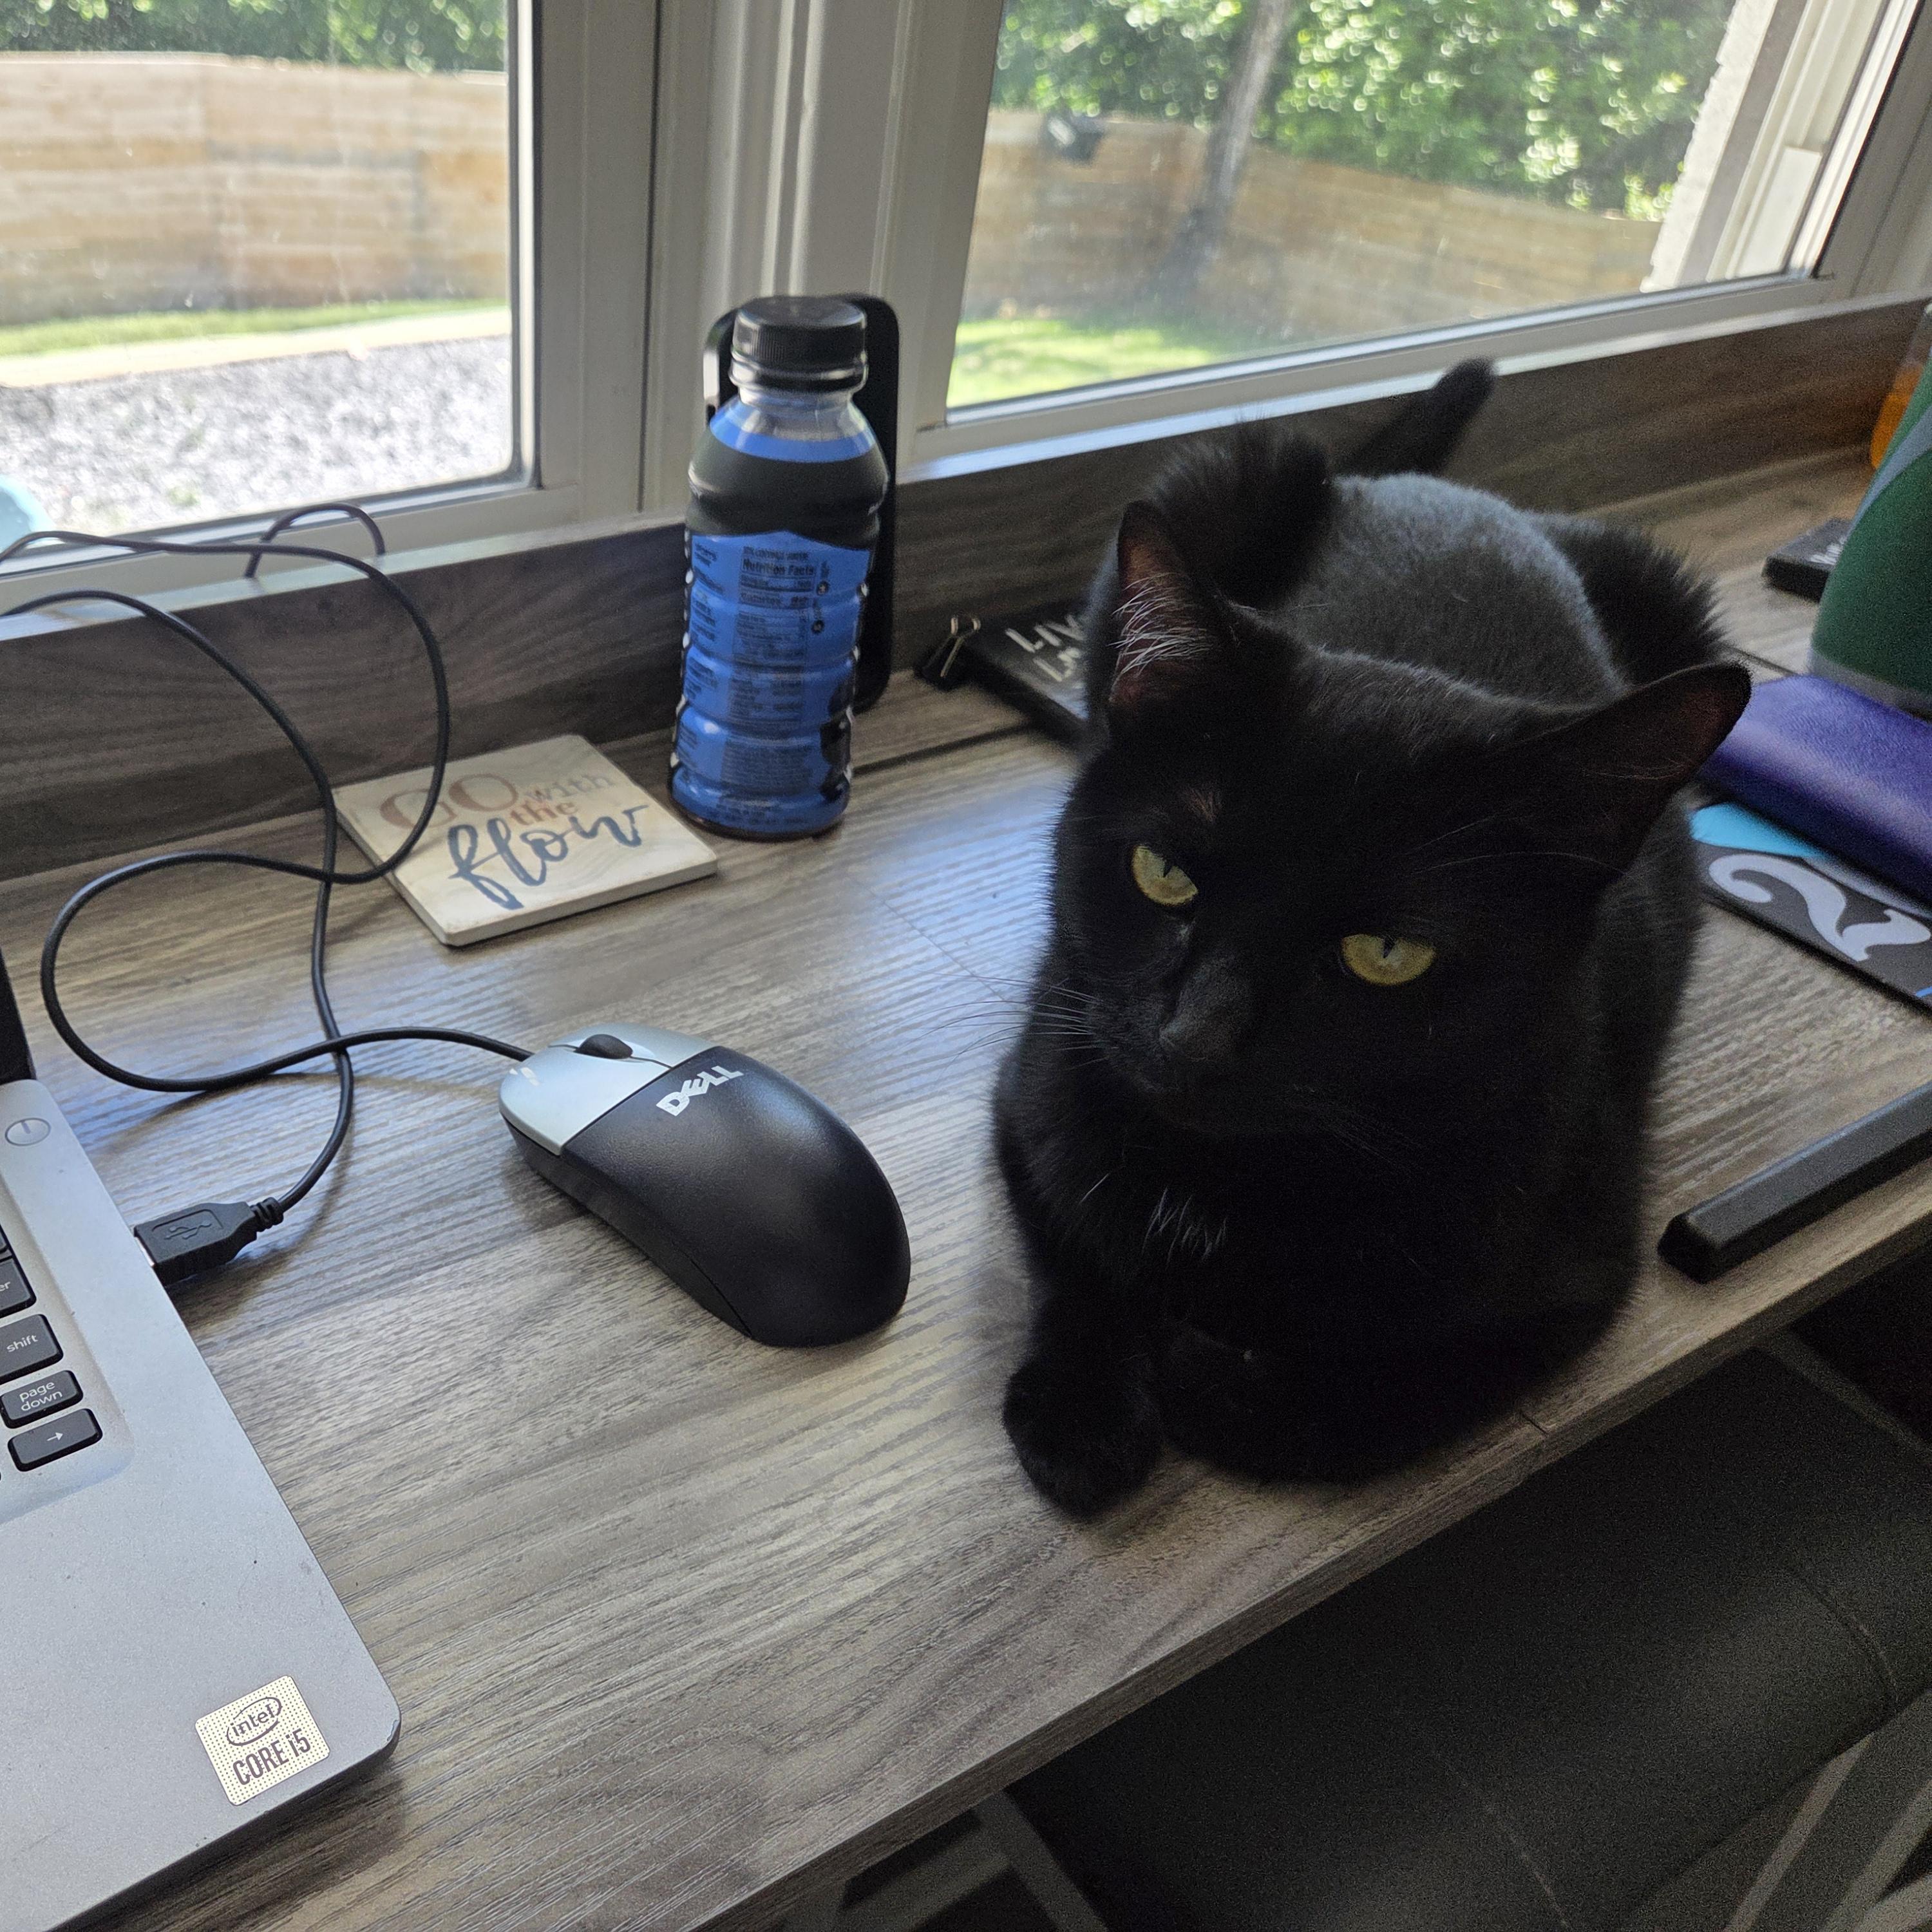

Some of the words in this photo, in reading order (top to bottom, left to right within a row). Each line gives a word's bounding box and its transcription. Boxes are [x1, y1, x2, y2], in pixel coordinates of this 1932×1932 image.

[379, 773, 518, 829] GO
[525, 774, 614, 801] with
[509, 799, 578, 826] the
[448, 804, 649, 910] flow
[656, 1065, 744, 1117] DELL
[6, 1334, 38, 1352] shift
[19, 1381, 56, 1403] page
[21, 1390, 63, 1411] down
[231, 1703, 275, 1737] intel
[232, 1739, 290, 1786] CORE
[285, 1728, 311, 1757] i5
